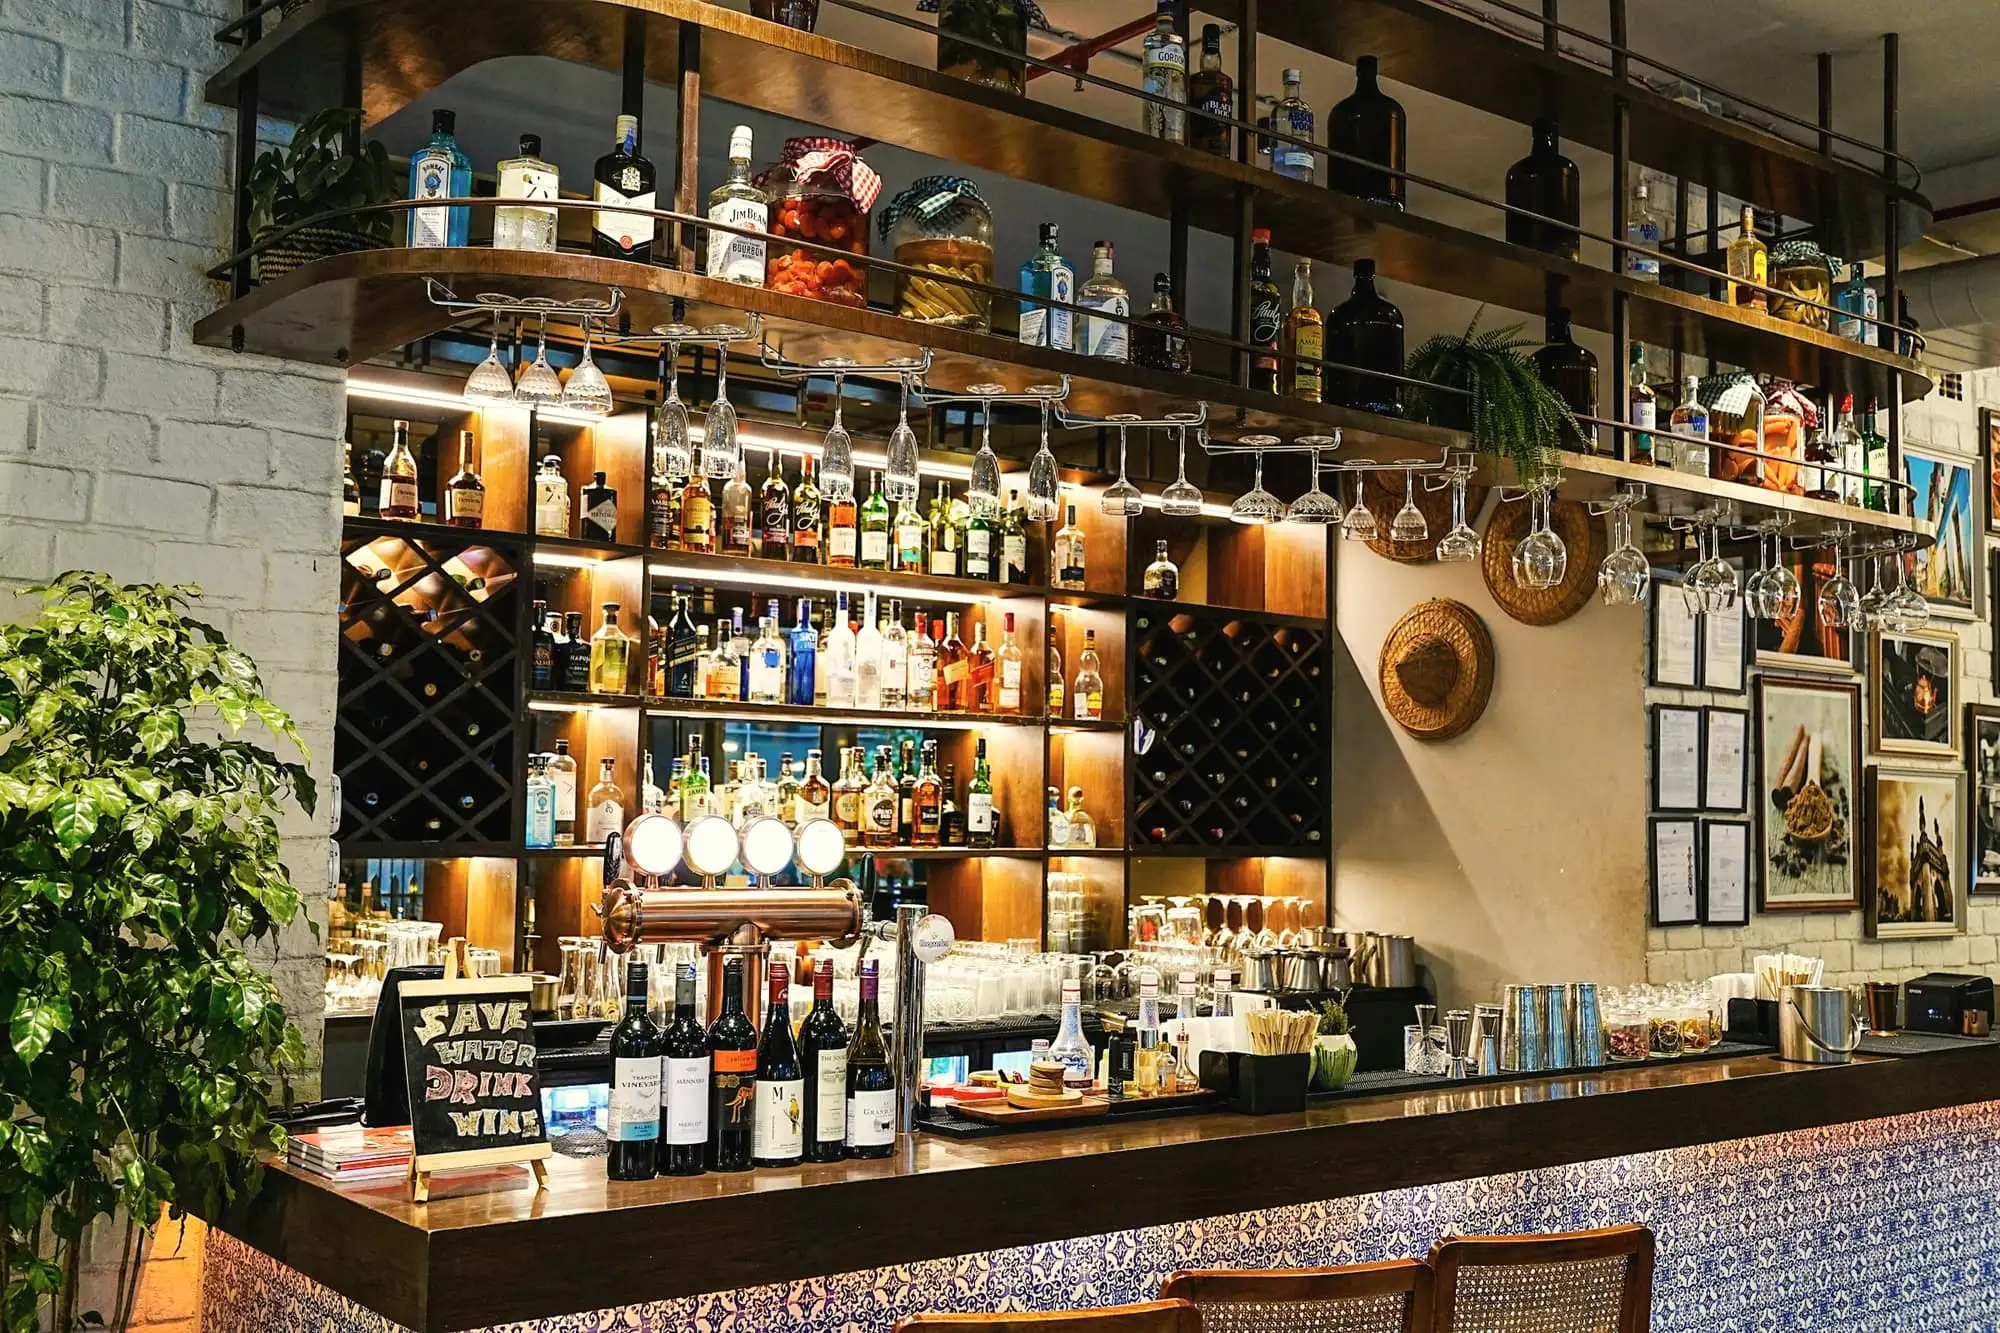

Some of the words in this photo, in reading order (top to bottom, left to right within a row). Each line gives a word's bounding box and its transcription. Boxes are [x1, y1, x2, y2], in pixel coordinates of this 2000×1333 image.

[729, 208, 746, 223] JIM
[732, 242, 764, 257] BOURBON
[413, 1000, 529, 1046] SAVE
[433, 1040, 537, 1067] WATER
[425, 1065, 533, 1104] DRINK
[448, 1109, 540, 1138] WINE
